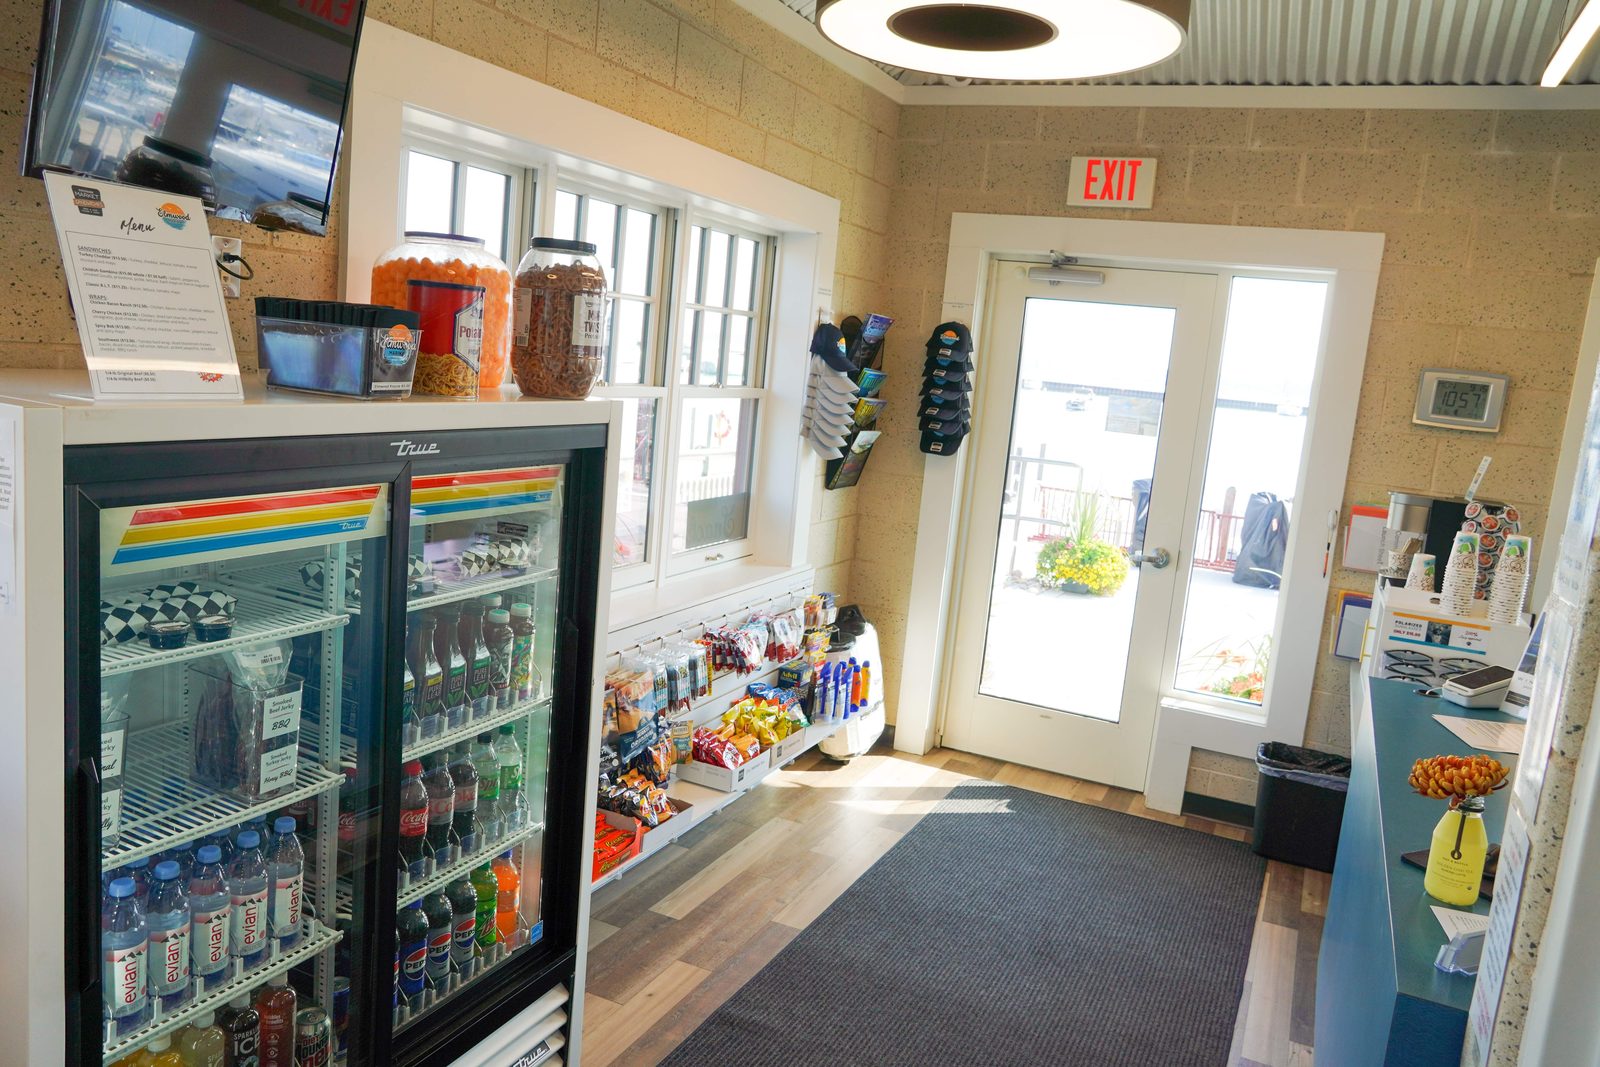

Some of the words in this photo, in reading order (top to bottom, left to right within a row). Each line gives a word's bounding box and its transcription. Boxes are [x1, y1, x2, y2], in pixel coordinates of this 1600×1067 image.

[1083, 159, 1143, 201] EXIT
[120, 216, 155, 235] Menu
[781, 671, 798, 679] Advil
[272, 697, 293, 707] Smoked
[280, 703, 295, 713] Jerky
[271, 718, 291, 731] BBQ
[270, 751, 288, 761] Smoked
[278, 754, 292, 765] Jerky
[279, 768, 294, 779] BBQ
[288, 887, 300, 925] evian
[244, 904, 257, 945] evian
[210, 920, 223, 963] evian
[167, 940, 180, 984] evian
[124, 961, 137, 1004] evian
